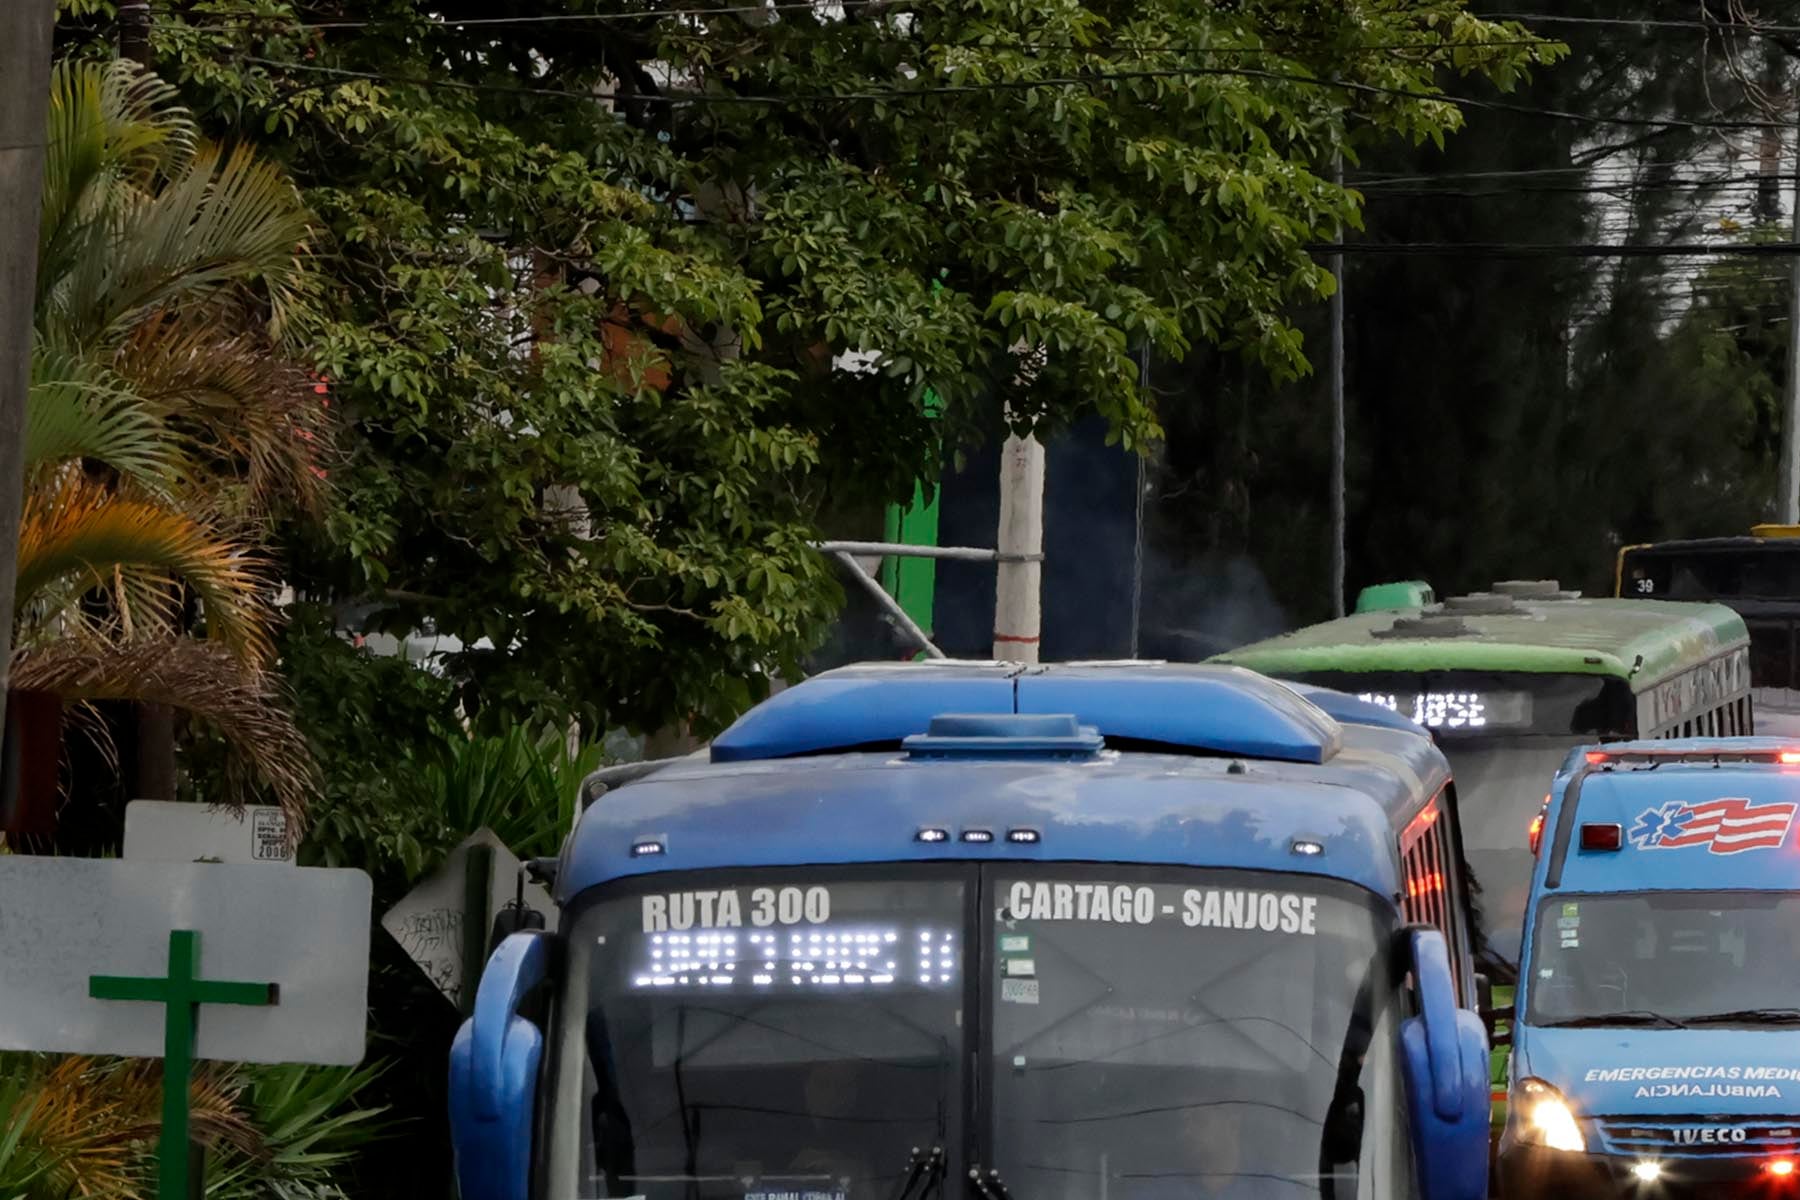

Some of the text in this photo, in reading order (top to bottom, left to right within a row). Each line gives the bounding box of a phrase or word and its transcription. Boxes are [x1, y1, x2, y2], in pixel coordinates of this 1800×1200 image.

[1637, 579, 1653, 593] 39
[642, 886, 831, 933] RUTA 300
[1009, 881, 1154, 924] CARTAGO
[1182, 889, 1318, 935] SANJOSE
[1584, 1066, 1741, 1083] EMERGENCIAS
[1673, 1128, 1747, 1145] IVECO
